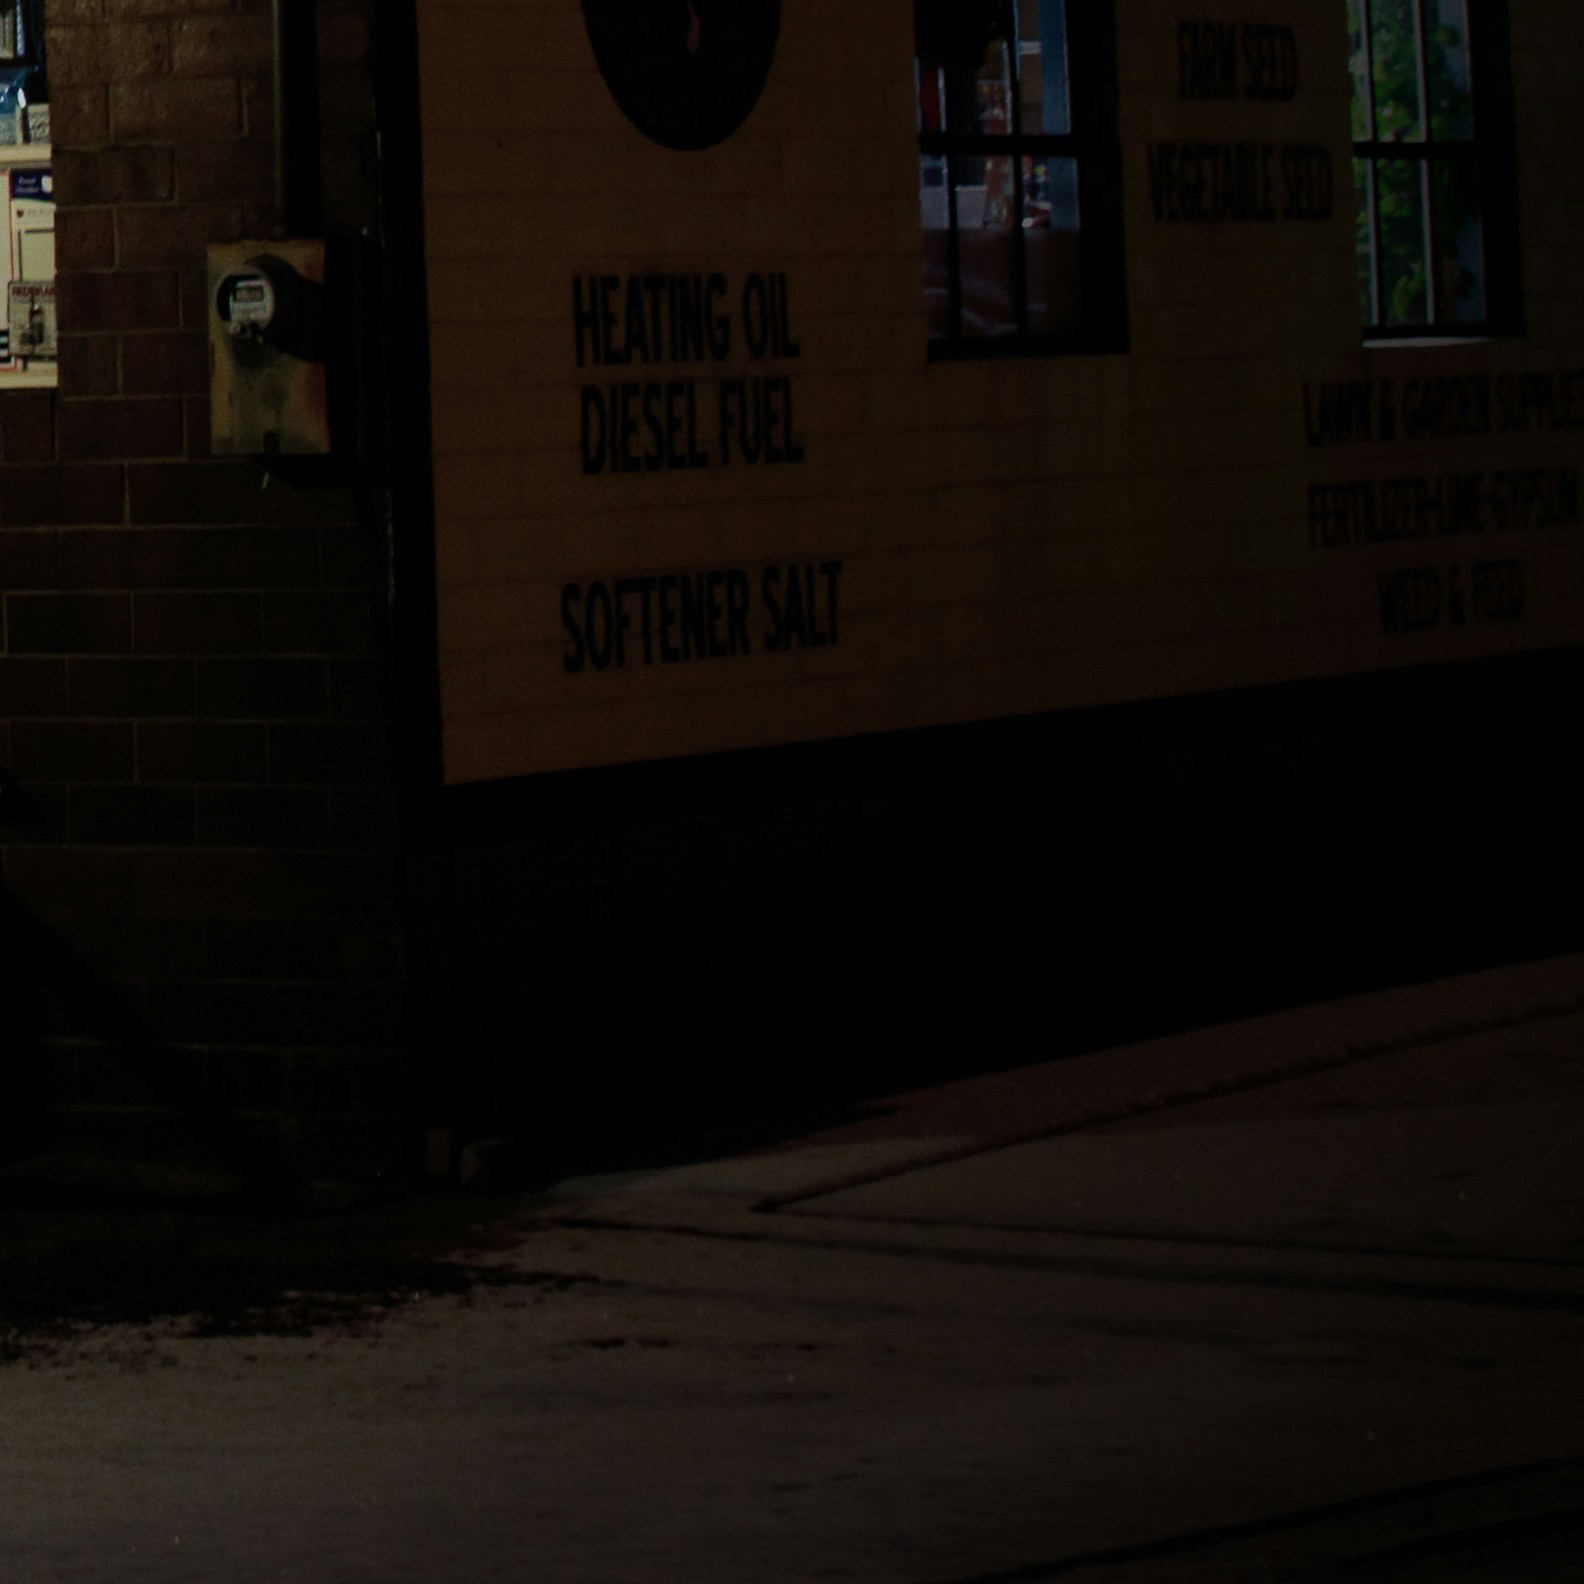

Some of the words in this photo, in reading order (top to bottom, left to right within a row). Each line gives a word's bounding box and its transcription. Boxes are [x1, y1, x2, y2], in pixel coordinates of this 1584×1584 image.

[1243, 22, 1298, 101] SEED
[1146, 142, 1275, 224] VEGETABLE
[1281, 144, 1333, 223] SEED
[572, 273, 732, 367] HEATING
[742, 271, 802, 360] OIL
[580, 381, 710, 476] DIESEL
[719, 376, 805, 466] FUEL
[1402, 373, 1491, 439] GARDEN
[561, 569, 751, 675] SOFTENER
[762, 560, 843, 651] SALT
